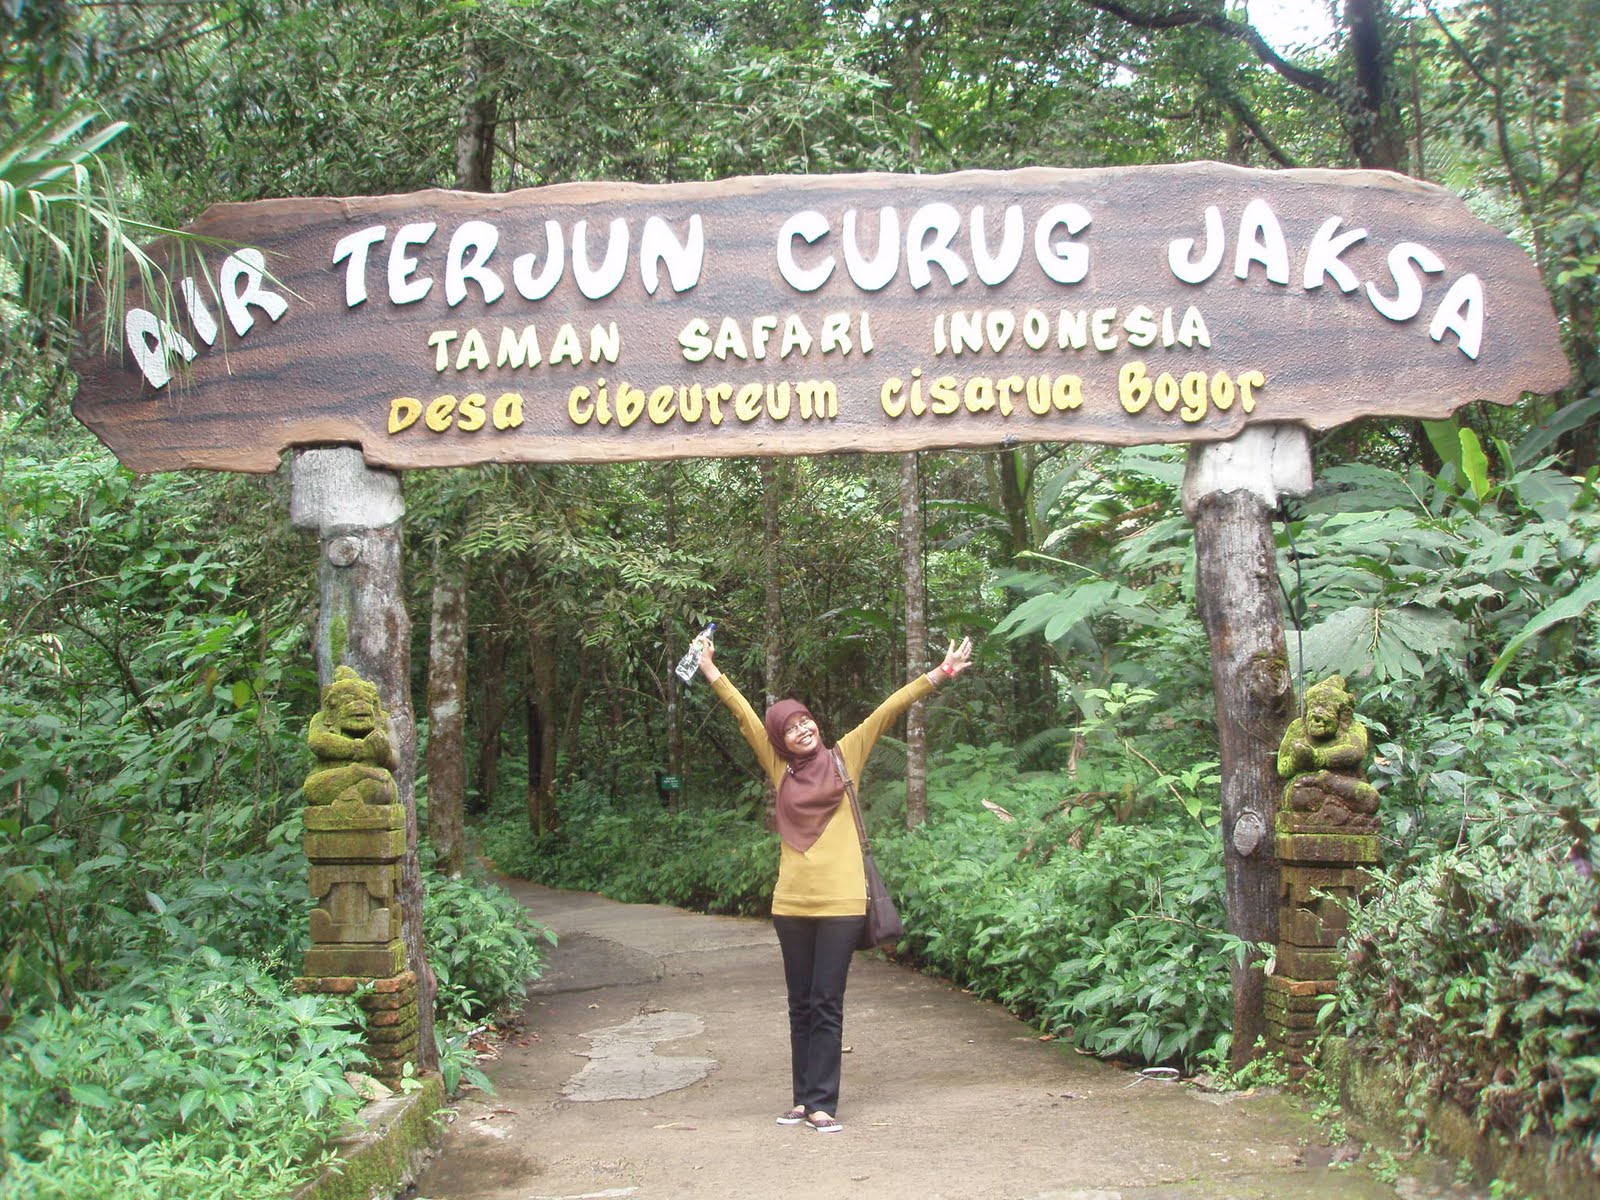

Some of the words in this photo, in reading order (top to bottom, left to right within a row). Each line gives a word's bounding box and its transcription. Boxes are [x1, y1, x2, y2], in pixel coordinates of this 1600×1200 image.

[126, 247, 288, 389] AIR
[333, 214, 703, 306] TERJUN
[777, 202, 1092, 292] CURUG
[1167, 199, 1485, 360] JAKSA
[428, 322, 620, 372] TAMAN
[678, 312, 873, 361] SAFARI
[934, 304, 1212, 356] INDONESIA
[387, 392, 524, 434] Desa
[1118, 361, 1265, 422] Bogor
